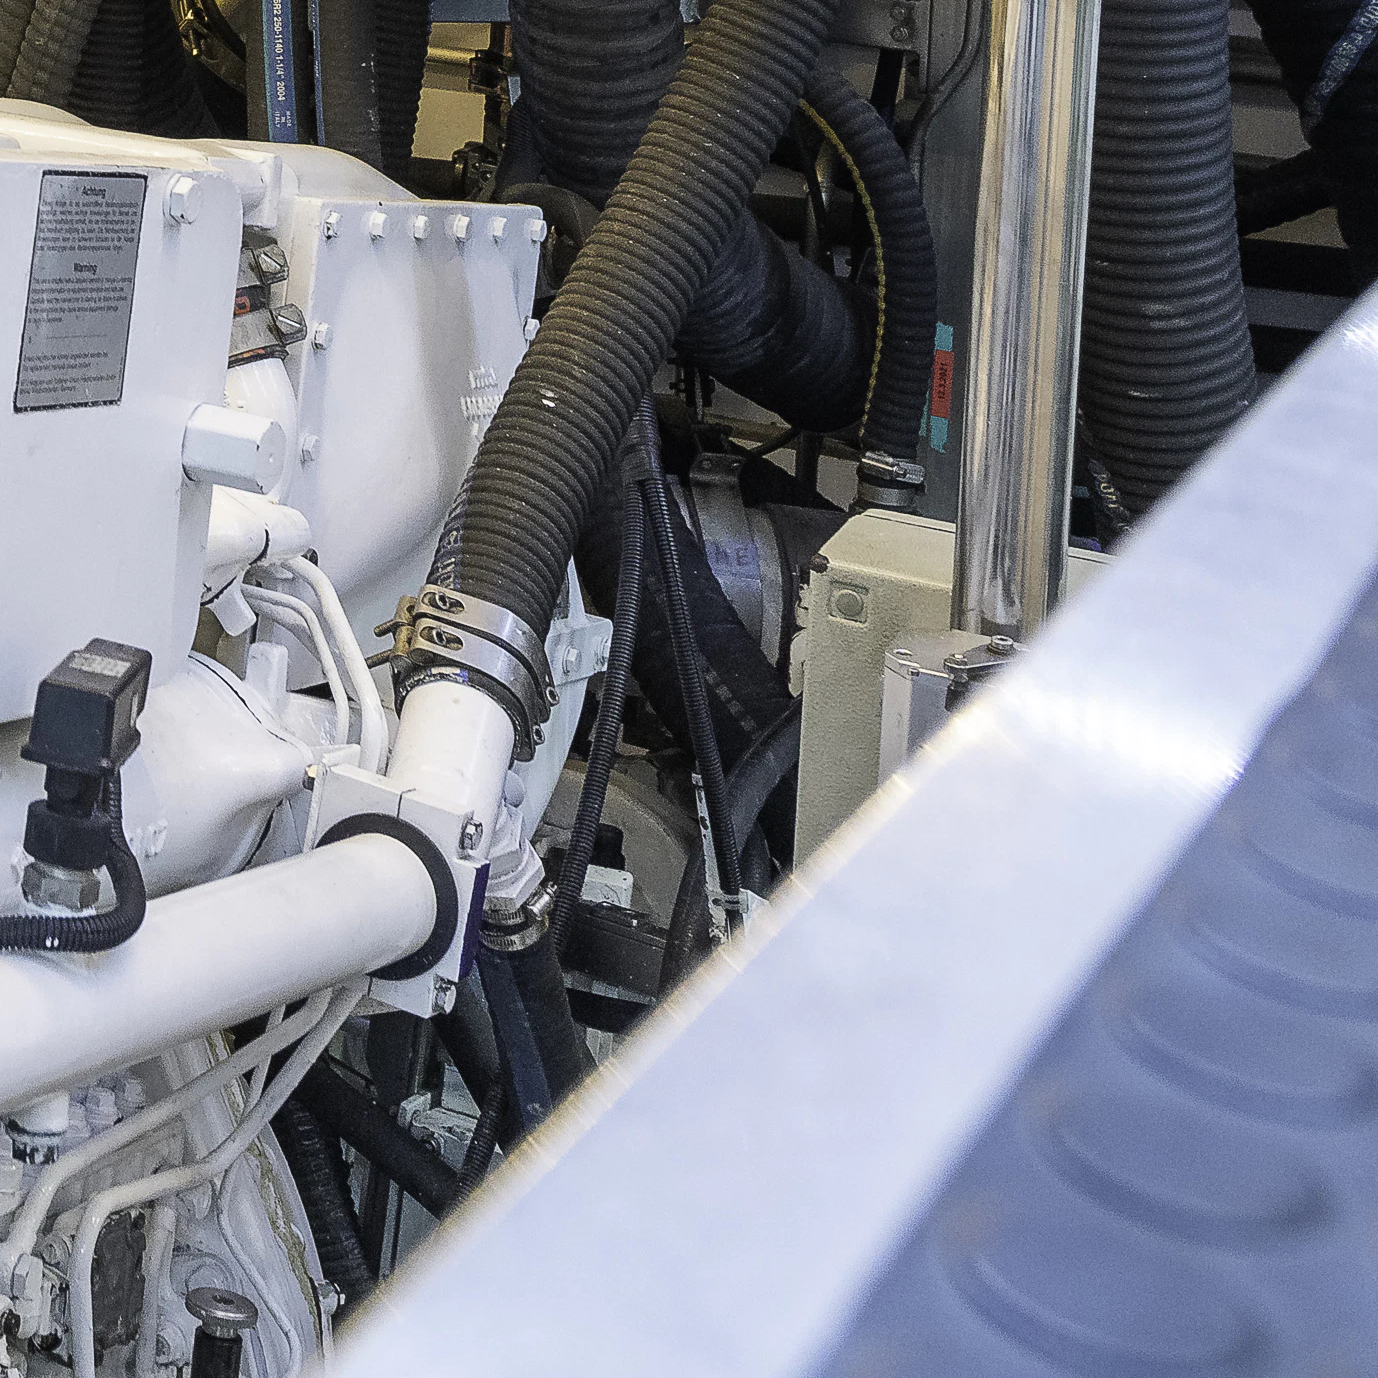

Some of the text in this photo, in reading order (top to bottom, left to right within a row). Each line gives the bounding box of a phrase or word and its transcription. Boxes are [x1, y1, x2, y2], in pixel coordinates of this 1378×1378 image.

[274, 17, 284, 54] 250-1140
[276, 81, 287, 101] 2004
[81, 185, 107, 199] Achtung
[73, 262, 98, 277] Warning
